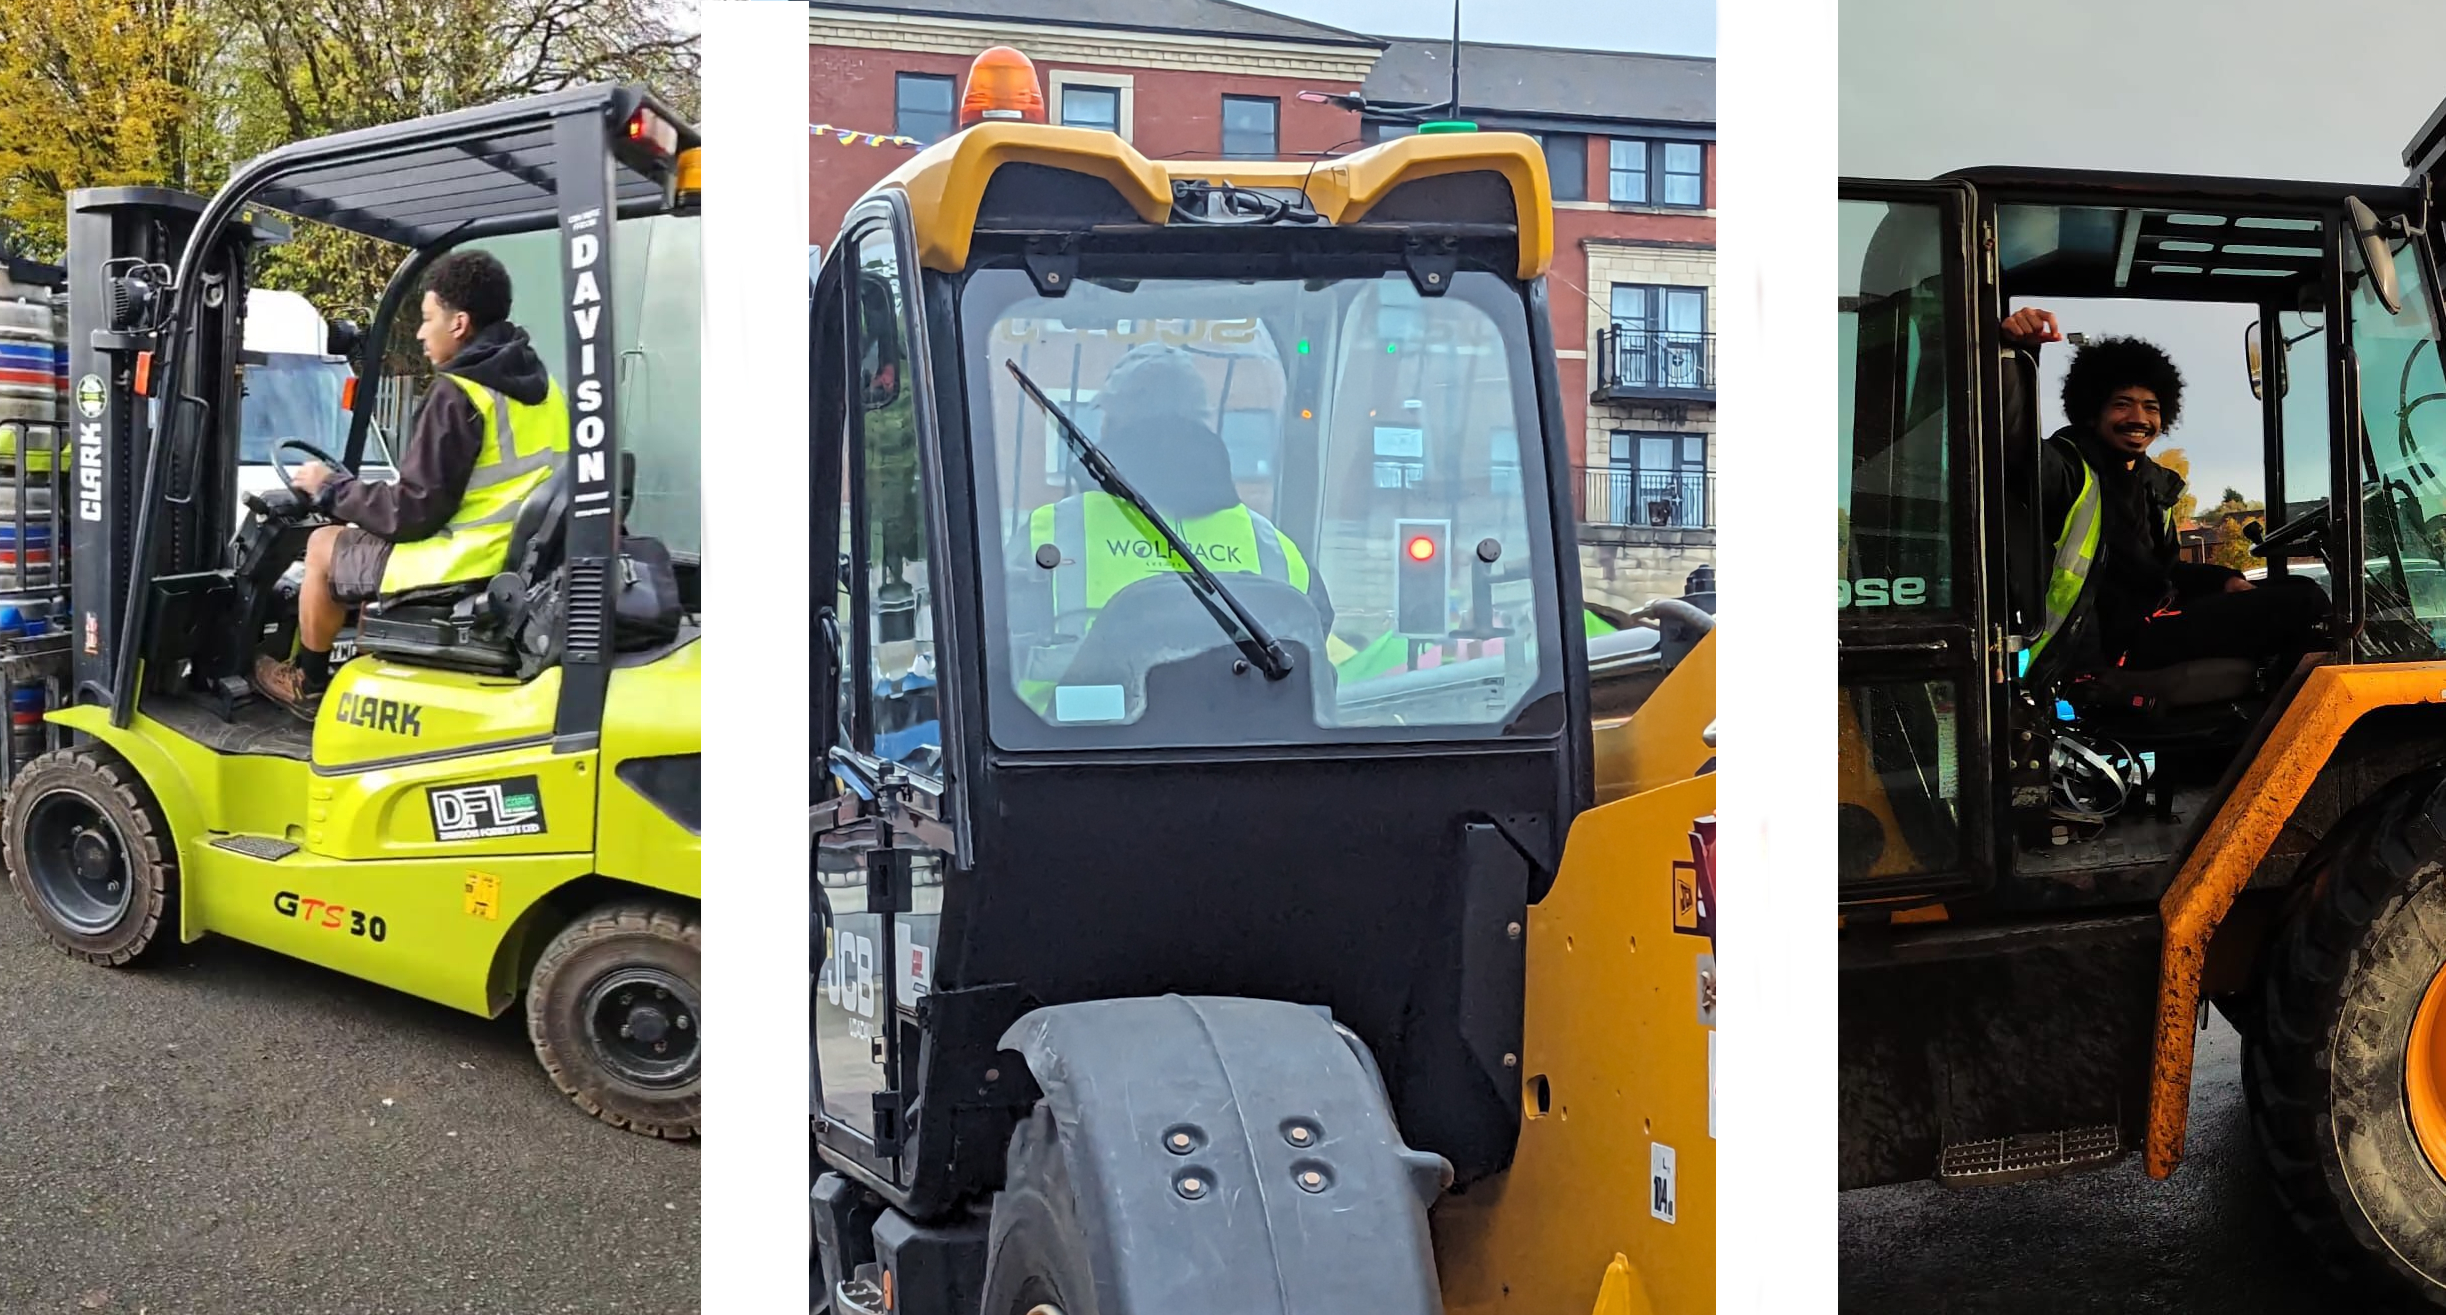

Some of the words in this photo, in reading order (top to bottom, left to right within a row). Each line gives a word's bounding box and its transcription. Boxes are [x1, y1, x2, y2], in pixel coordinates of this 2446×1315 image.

[571, 233, 606, 483] DAVISON
[80, 422, 102, 522] CLARK
[337, 692, 422, 737] CLARK
[431, 784, 538, 831] DFL
[274, 890, 345, 928] GTS
[350, 909, 387, 943] 30
[828, 930, 874, 1018] JCB
